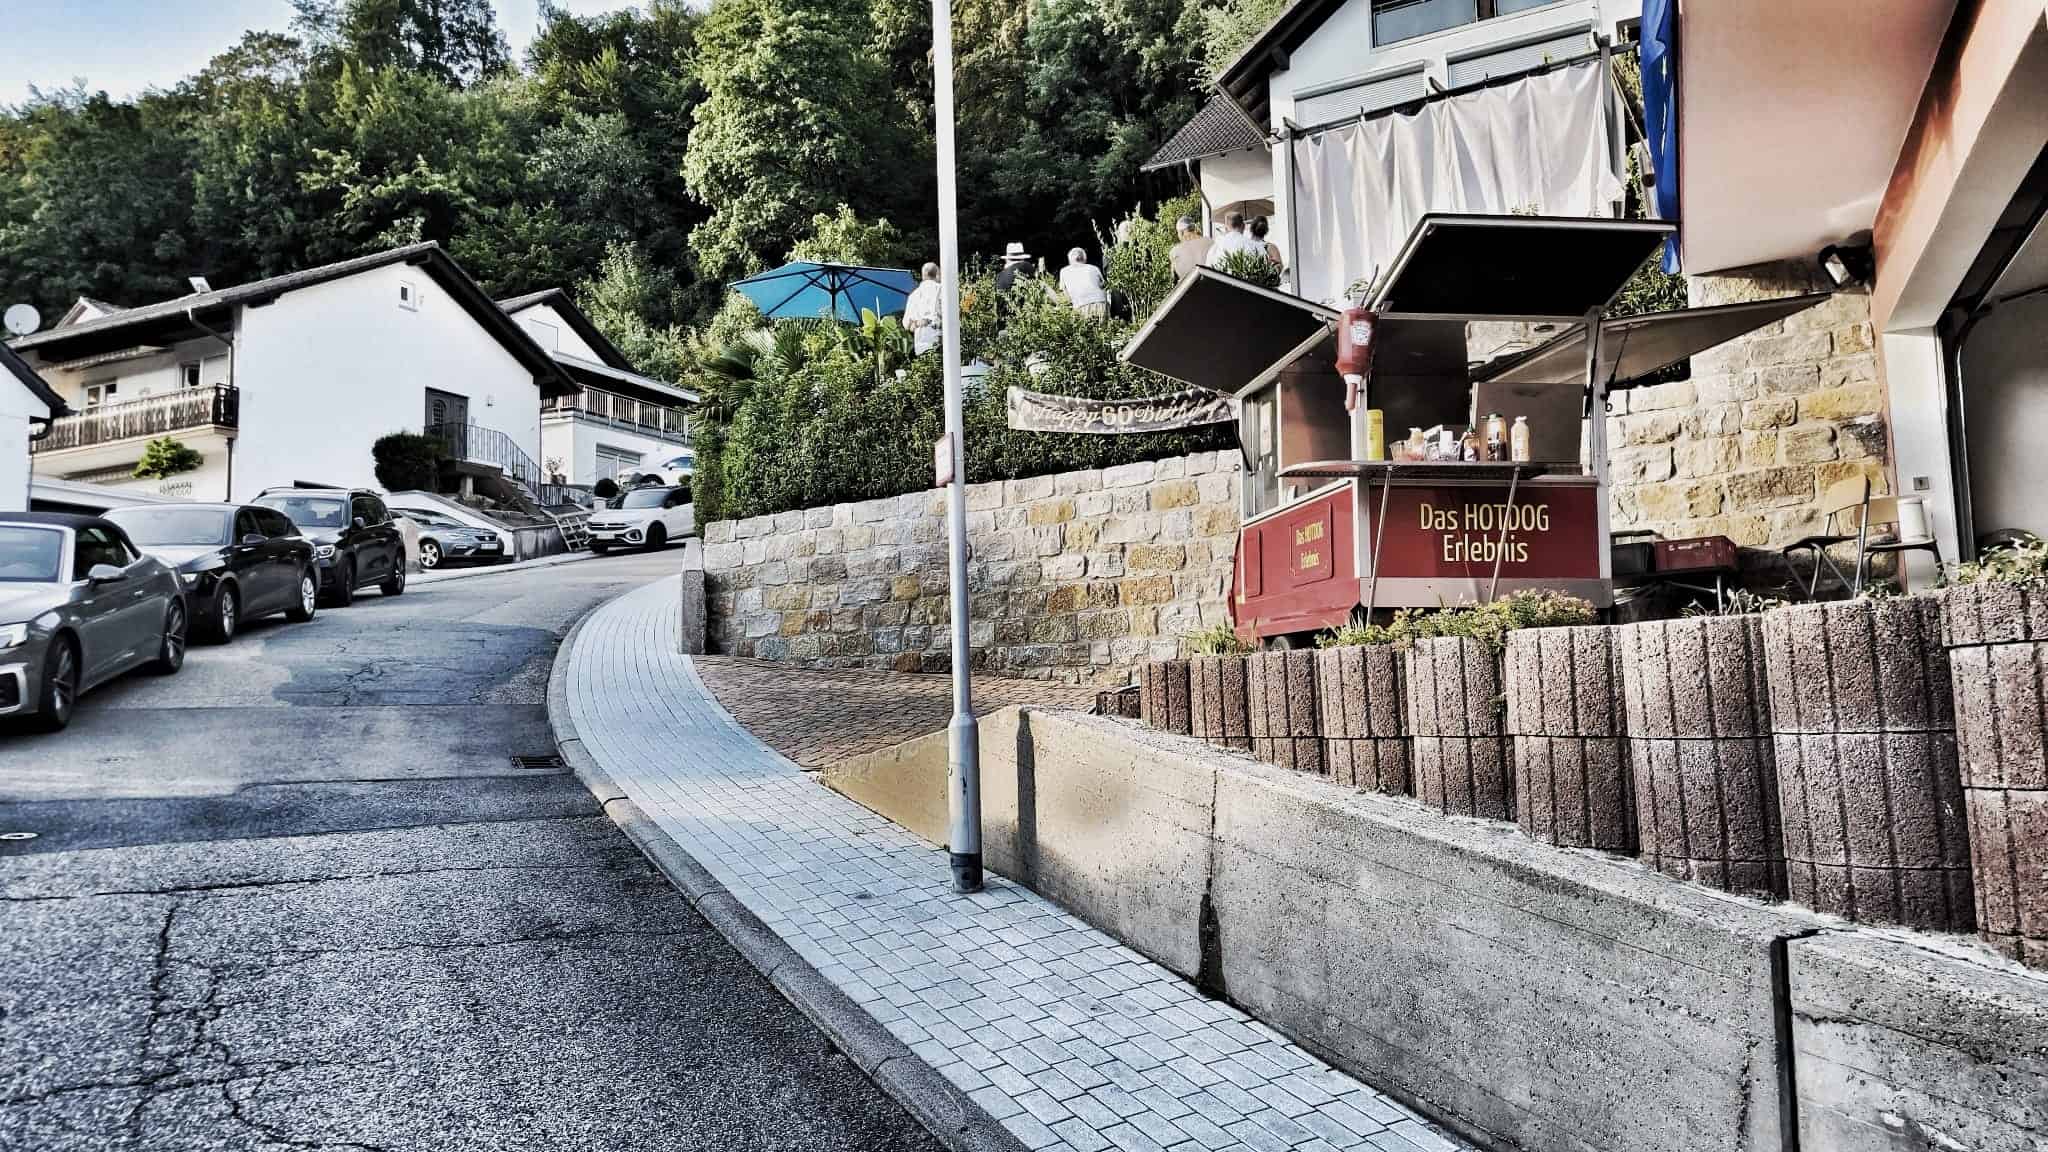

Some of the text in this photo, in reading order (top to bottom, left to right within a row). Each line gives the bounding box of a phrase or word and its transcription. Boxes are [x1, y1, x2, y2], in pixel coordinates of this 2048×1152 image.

[1102, 406, 1131, 426] 60
[1420, 503, 1549, 531] Das HOTDOG
[1443, 534, 1529, 562] Erlebnis
